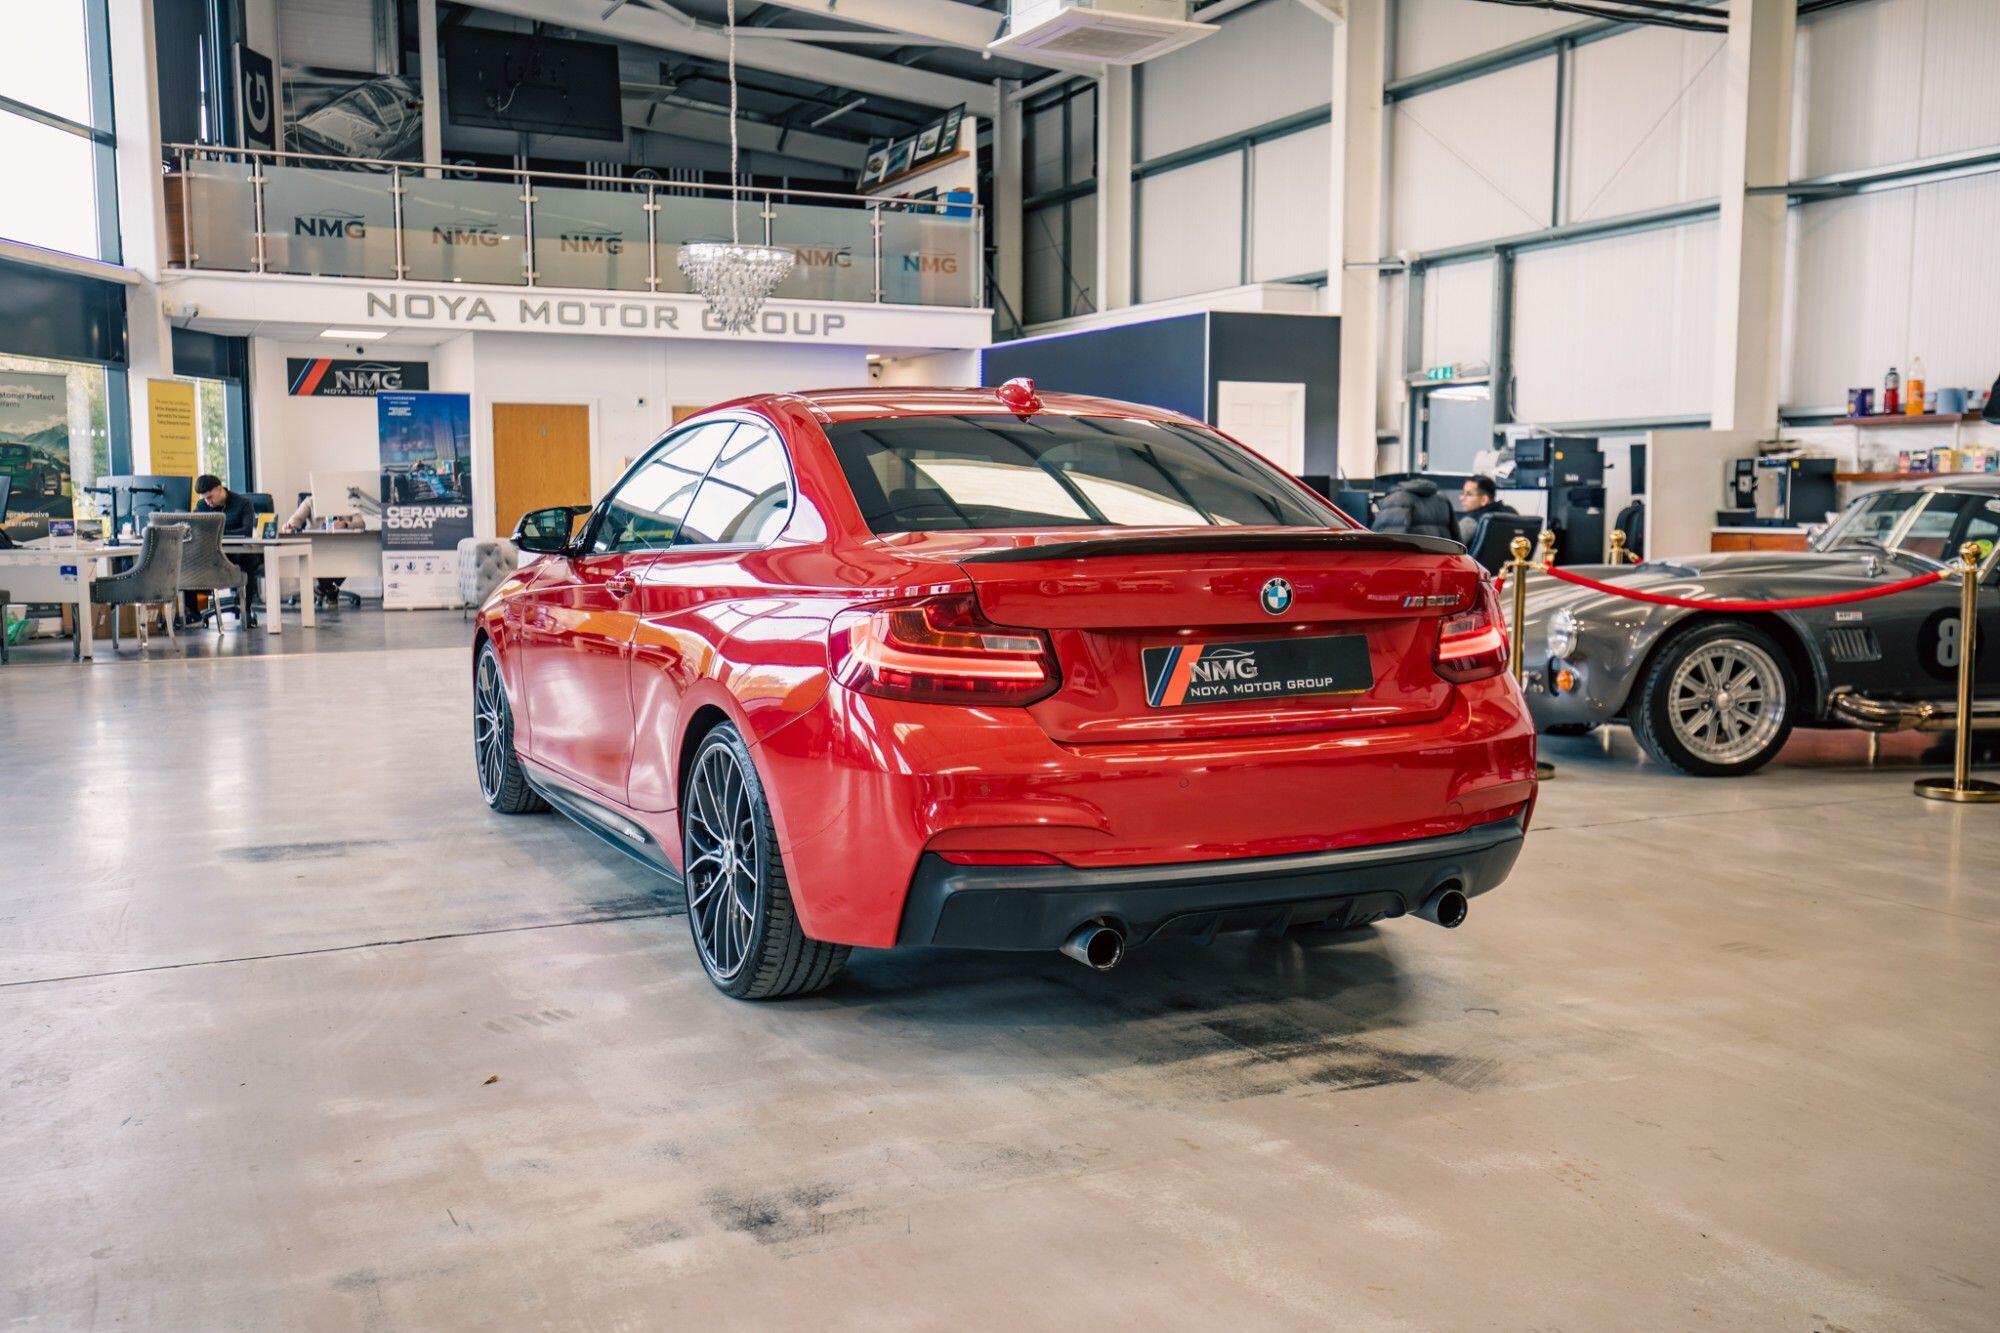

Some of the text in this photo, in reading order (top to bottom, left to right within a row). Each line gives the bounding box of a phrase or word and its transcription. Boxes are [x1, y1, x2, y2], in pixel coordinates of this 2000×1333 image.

[294, 216, 366, 239] NMG
[432, 226, 500, 247] NMG
[560, 234, 625, 255] NMG
[795, 249, 852, 268] NMG
[904, 254, 958, 274] NMG
[367, 291, 496, 323] NOYA
[520, 299, 679, 330] MOTOR
[335, 371, 402, 390] NMG
[387, 506, 468, 518] CERAMIC
[387, 518, 437, 529] COAT
[1937, 618, 1962, 667] 8
[1189, 659, 1259, 683] NMG
[1191, 677, 1334, 697] NOYA MOTOR GROUP
